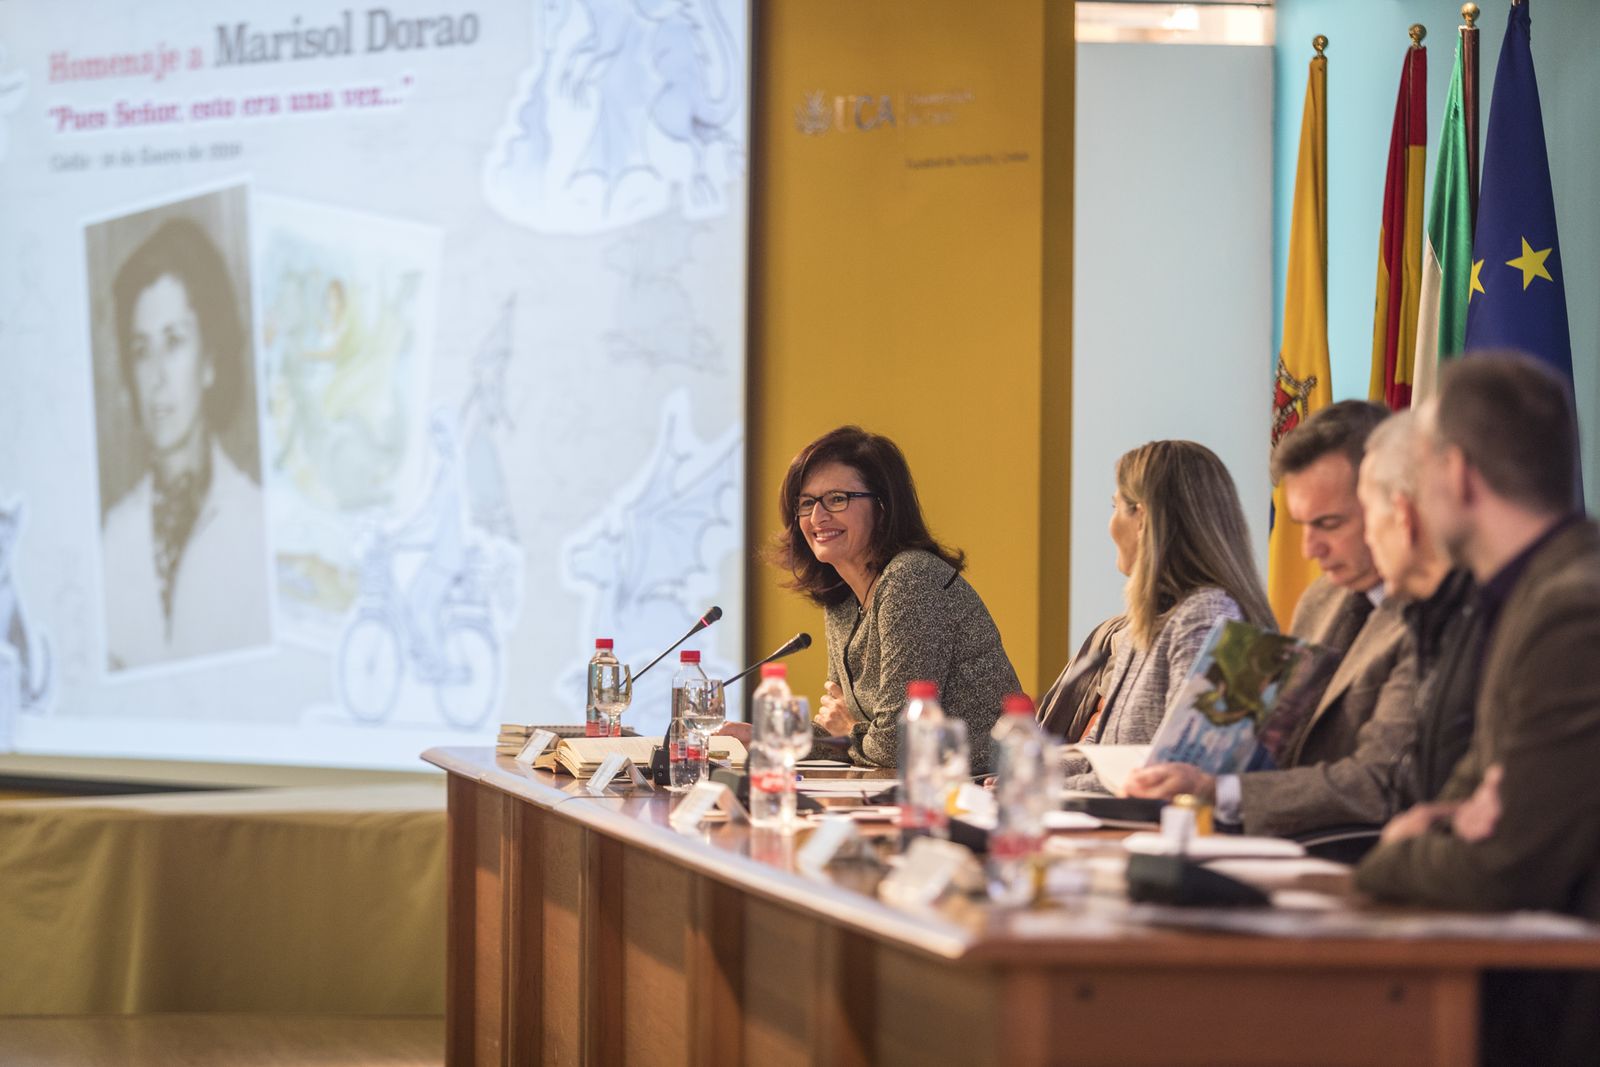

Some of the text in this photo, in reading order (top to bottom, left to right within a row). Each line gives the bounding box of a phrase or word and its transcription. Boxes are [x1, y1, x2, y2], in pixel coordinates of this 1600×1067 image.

[49, 7, 480, 83] Homenaje a Marisol Dorao
